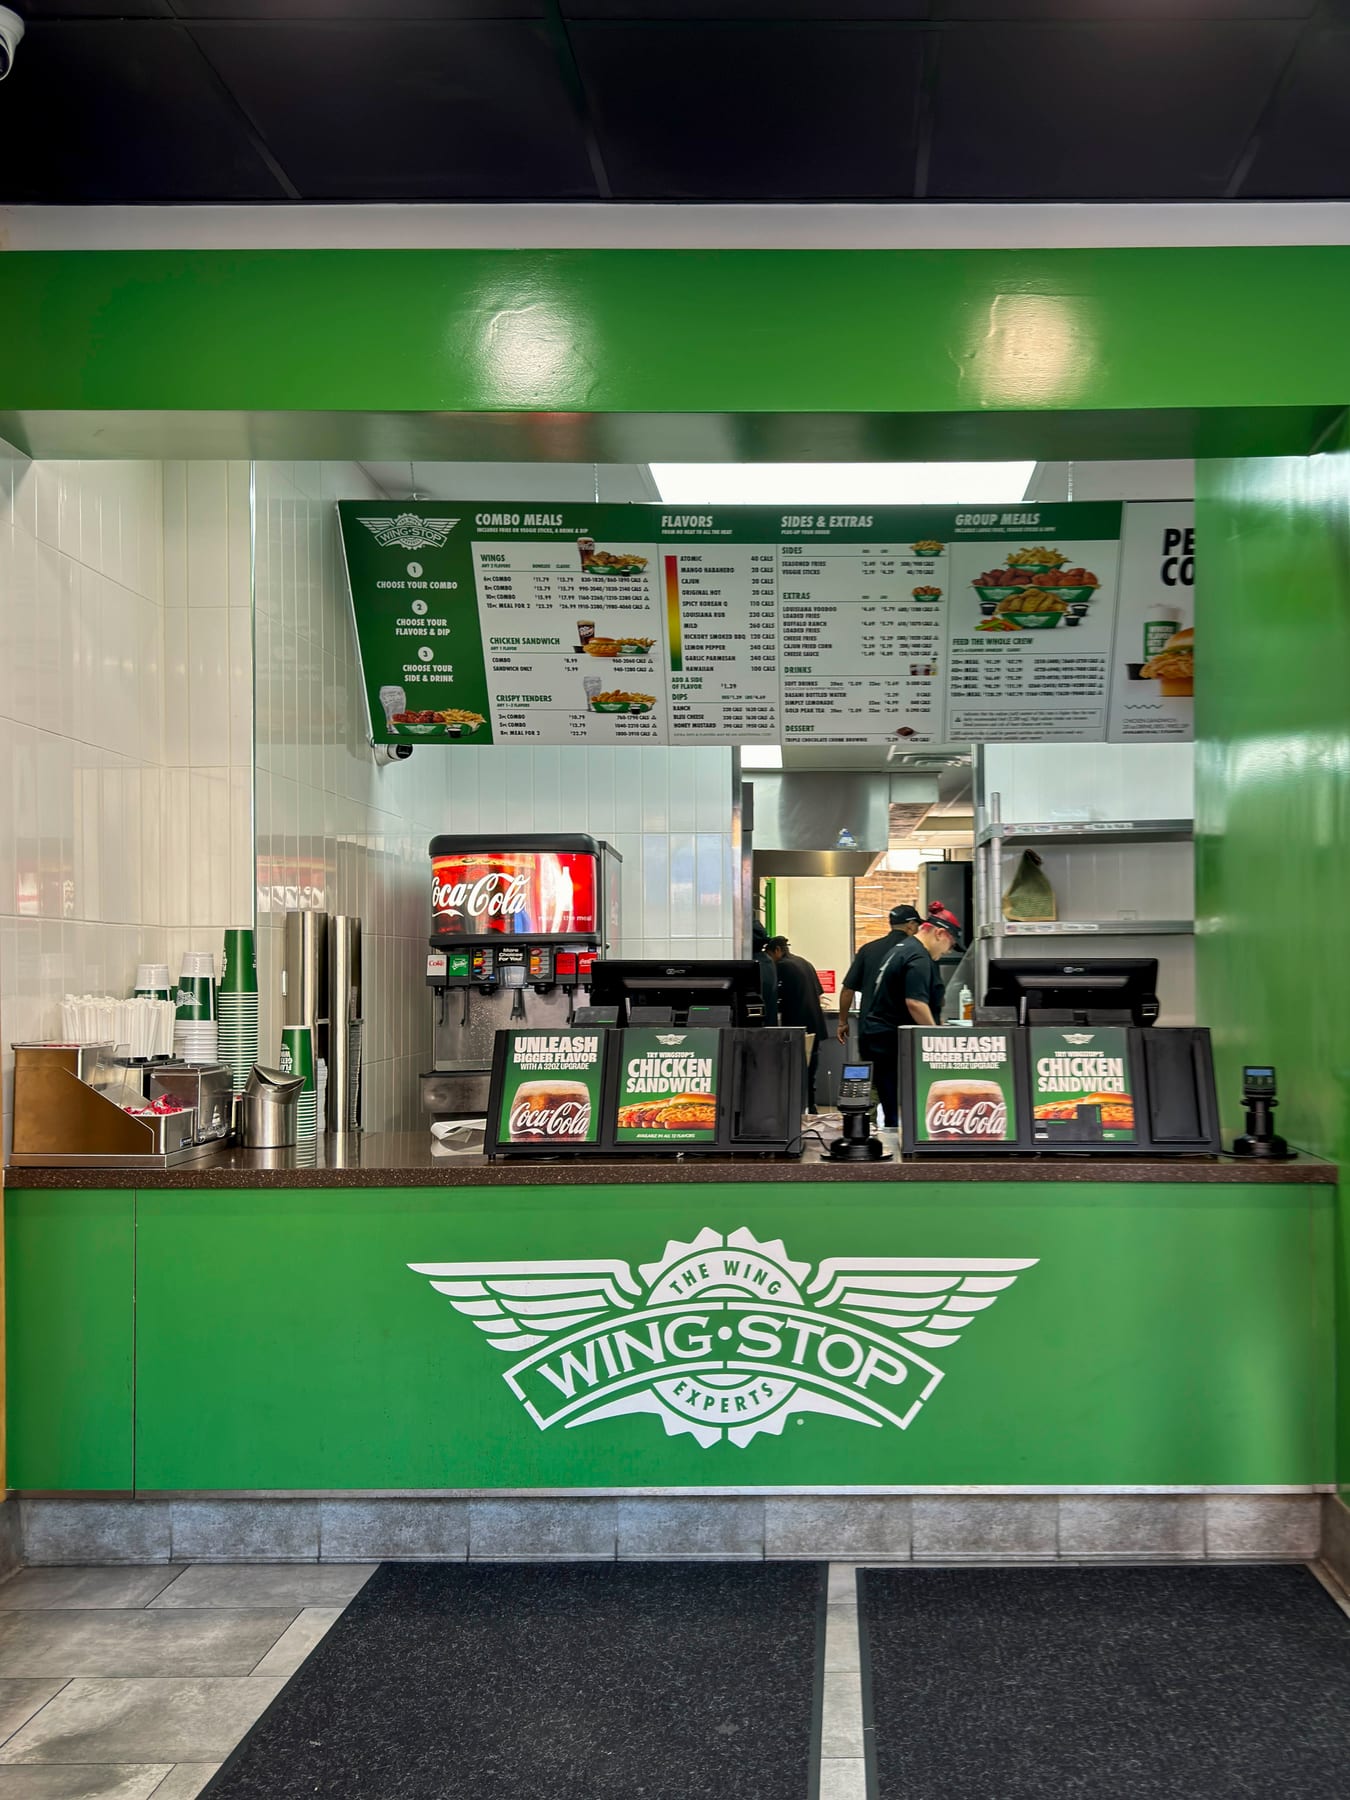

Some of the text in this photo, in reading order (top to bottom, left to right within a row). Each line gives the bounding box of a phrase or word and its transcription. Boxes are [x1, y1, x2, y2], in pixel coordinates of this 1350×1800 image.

[475, 514, 563, 526] COMBO MEALS
[661, 515, 713, 527] FLAVORS
[781, 515, 873, 527] SIDES & EXTRAS
[954, 513, 1040, 525] GROUP MEALS
[480, 554, 506, 562] WINGS
[376, 581, 458, 589] CHOOSE YOUR COMBO
[396, 618, 448, 626] CHOOSE YOUR
[395, 628, 428, 636] FLAVORS
[437, 628, 451, 636] DIP
[489, 637, 560, 645] CHICKEN SANDWICH
[402, 664, 453, 672] CHOOSE YOUR
[784, 666, 812, 674] DRINKS
[672, 693, 688, 701] DIPS
[514, 1036, 598, 1053] UNLEASH
[922, 1036, 1006, 1052] UNLEASH
[513, 1053, 597, 1063] BIGGER FLAVOR
[922, 1052, 1007, 1062] BIGGER FLAVOR
[628, 1058, 712, 1077] CHICKEN
[1037, 1058, 1124, 1076] CHICKEN
[626, 1078, 712, 1093] SANDWICH
[1038, 1077, 1125, 1092] SANDWICH
[509, 1102, 591, 1135] Coca-Cola
[925, 1101, 1007, 1134] Coca-Cola
[668, 1260, 782, 1295] THE WING
[671, 1381, 776, 1413] EXPERTS
